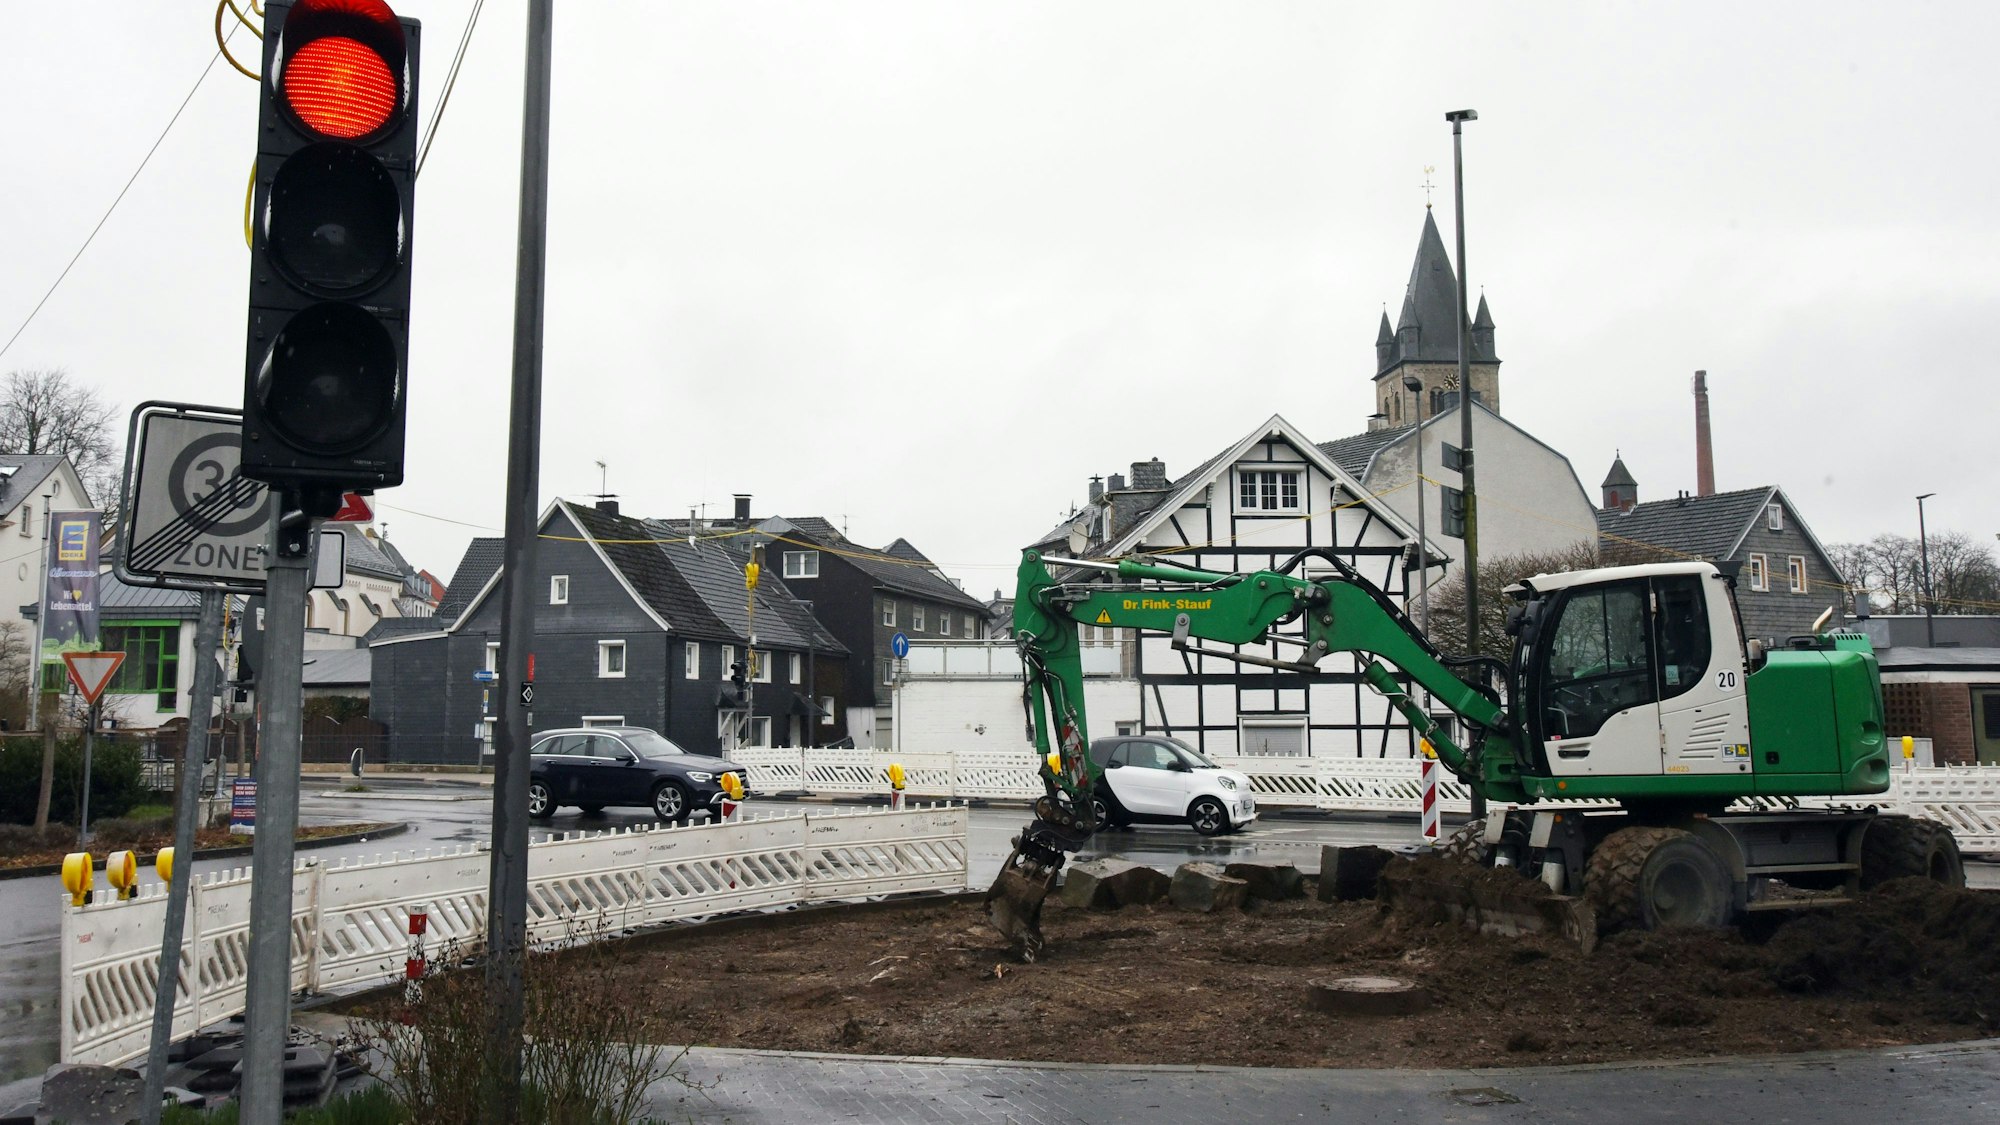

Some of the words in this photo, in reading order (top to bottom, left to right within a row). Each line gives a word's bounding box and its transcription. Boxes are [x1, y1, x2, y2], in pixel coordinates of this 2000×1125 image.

[192, 460, 258, 509] 30
[174, 540, 259, 571] ZONE
[63, 590, 73, 599] Wir
[1122, 599, 1140, 610] Dr.
[1141, 598, 1212, 610] Fink-Stauf
[1718, 671, 1735, 688] 20
